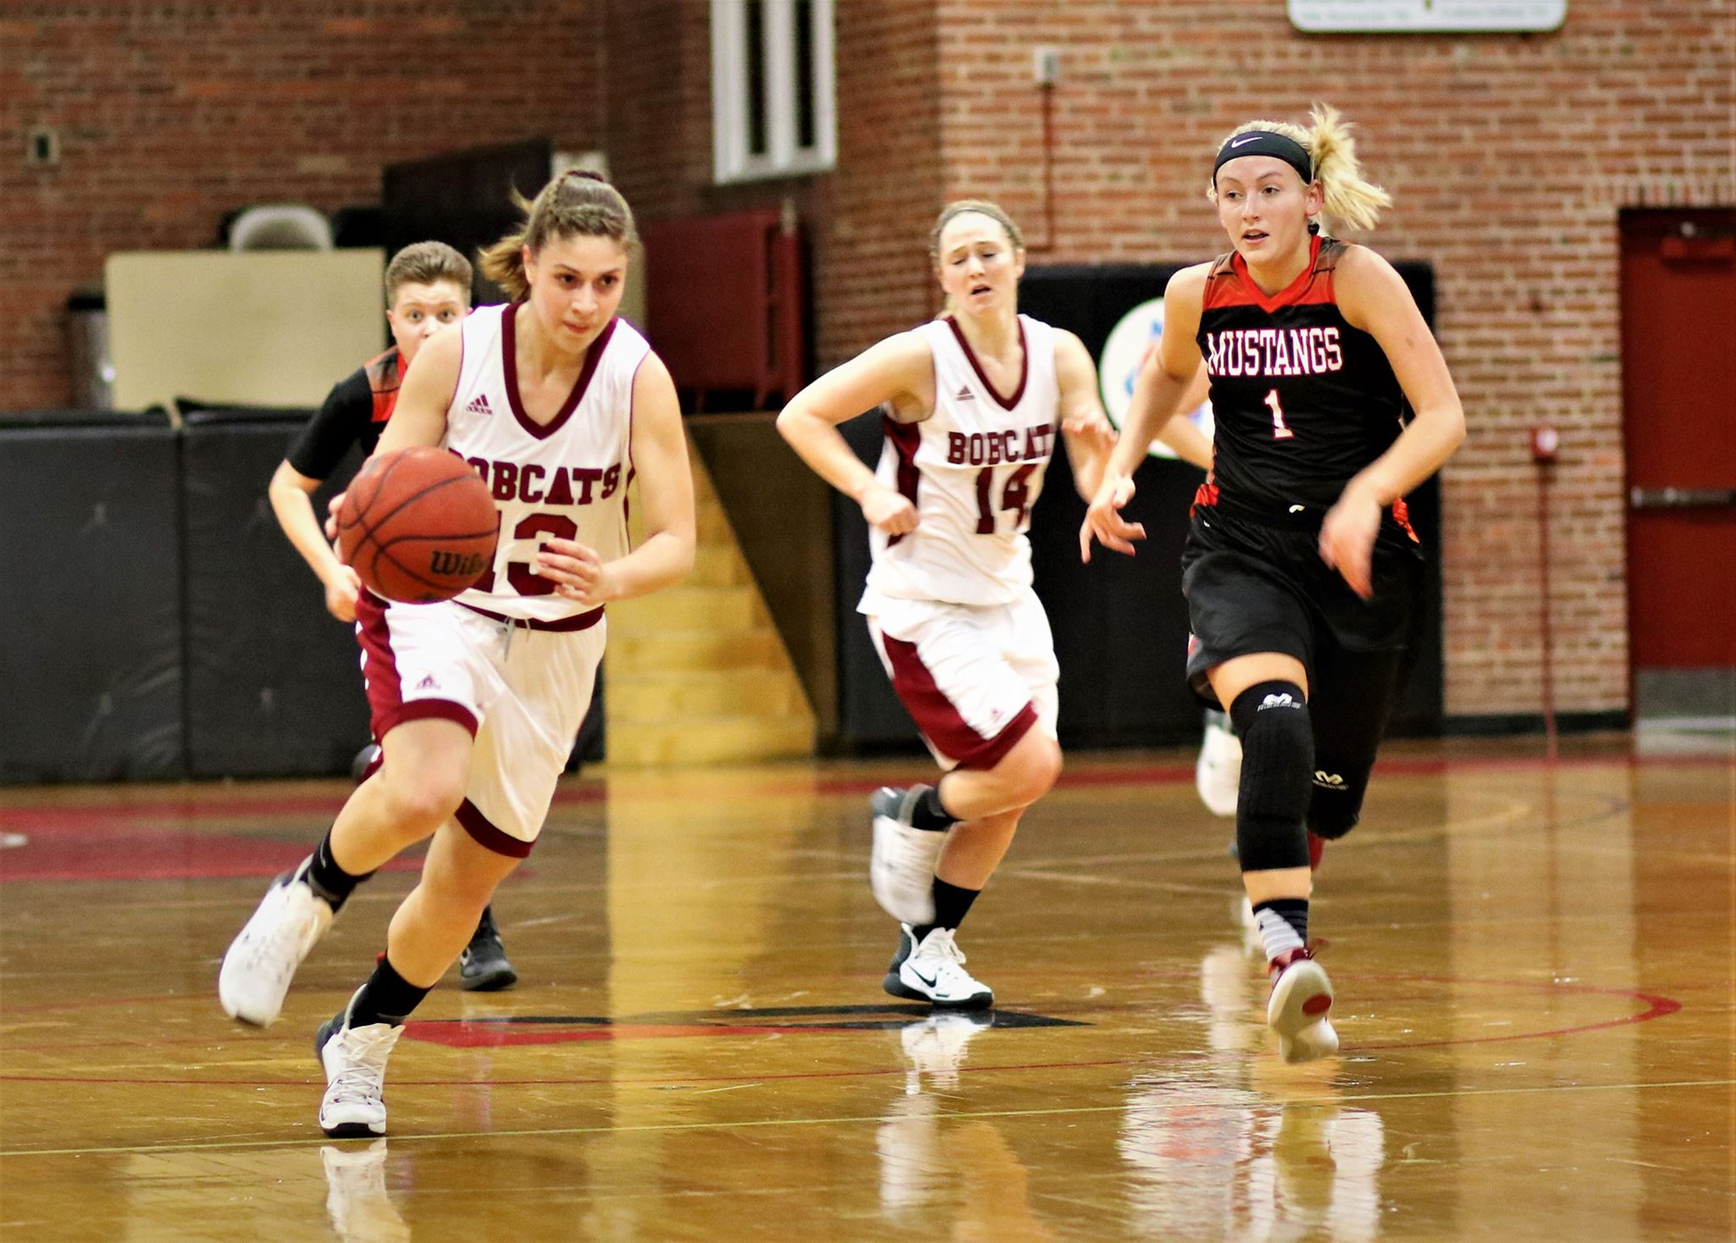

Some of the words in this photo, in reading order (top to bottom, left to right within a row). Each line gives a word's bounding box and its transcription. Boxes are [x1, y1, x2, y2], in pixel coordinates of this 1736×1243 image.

[1206, 327, 1343, 376] MUSTANGS
[1264, 389, 1293, 438] 1
[448, 448, 621, 505] BCATS
[976, 463, 1036, 534] 14
